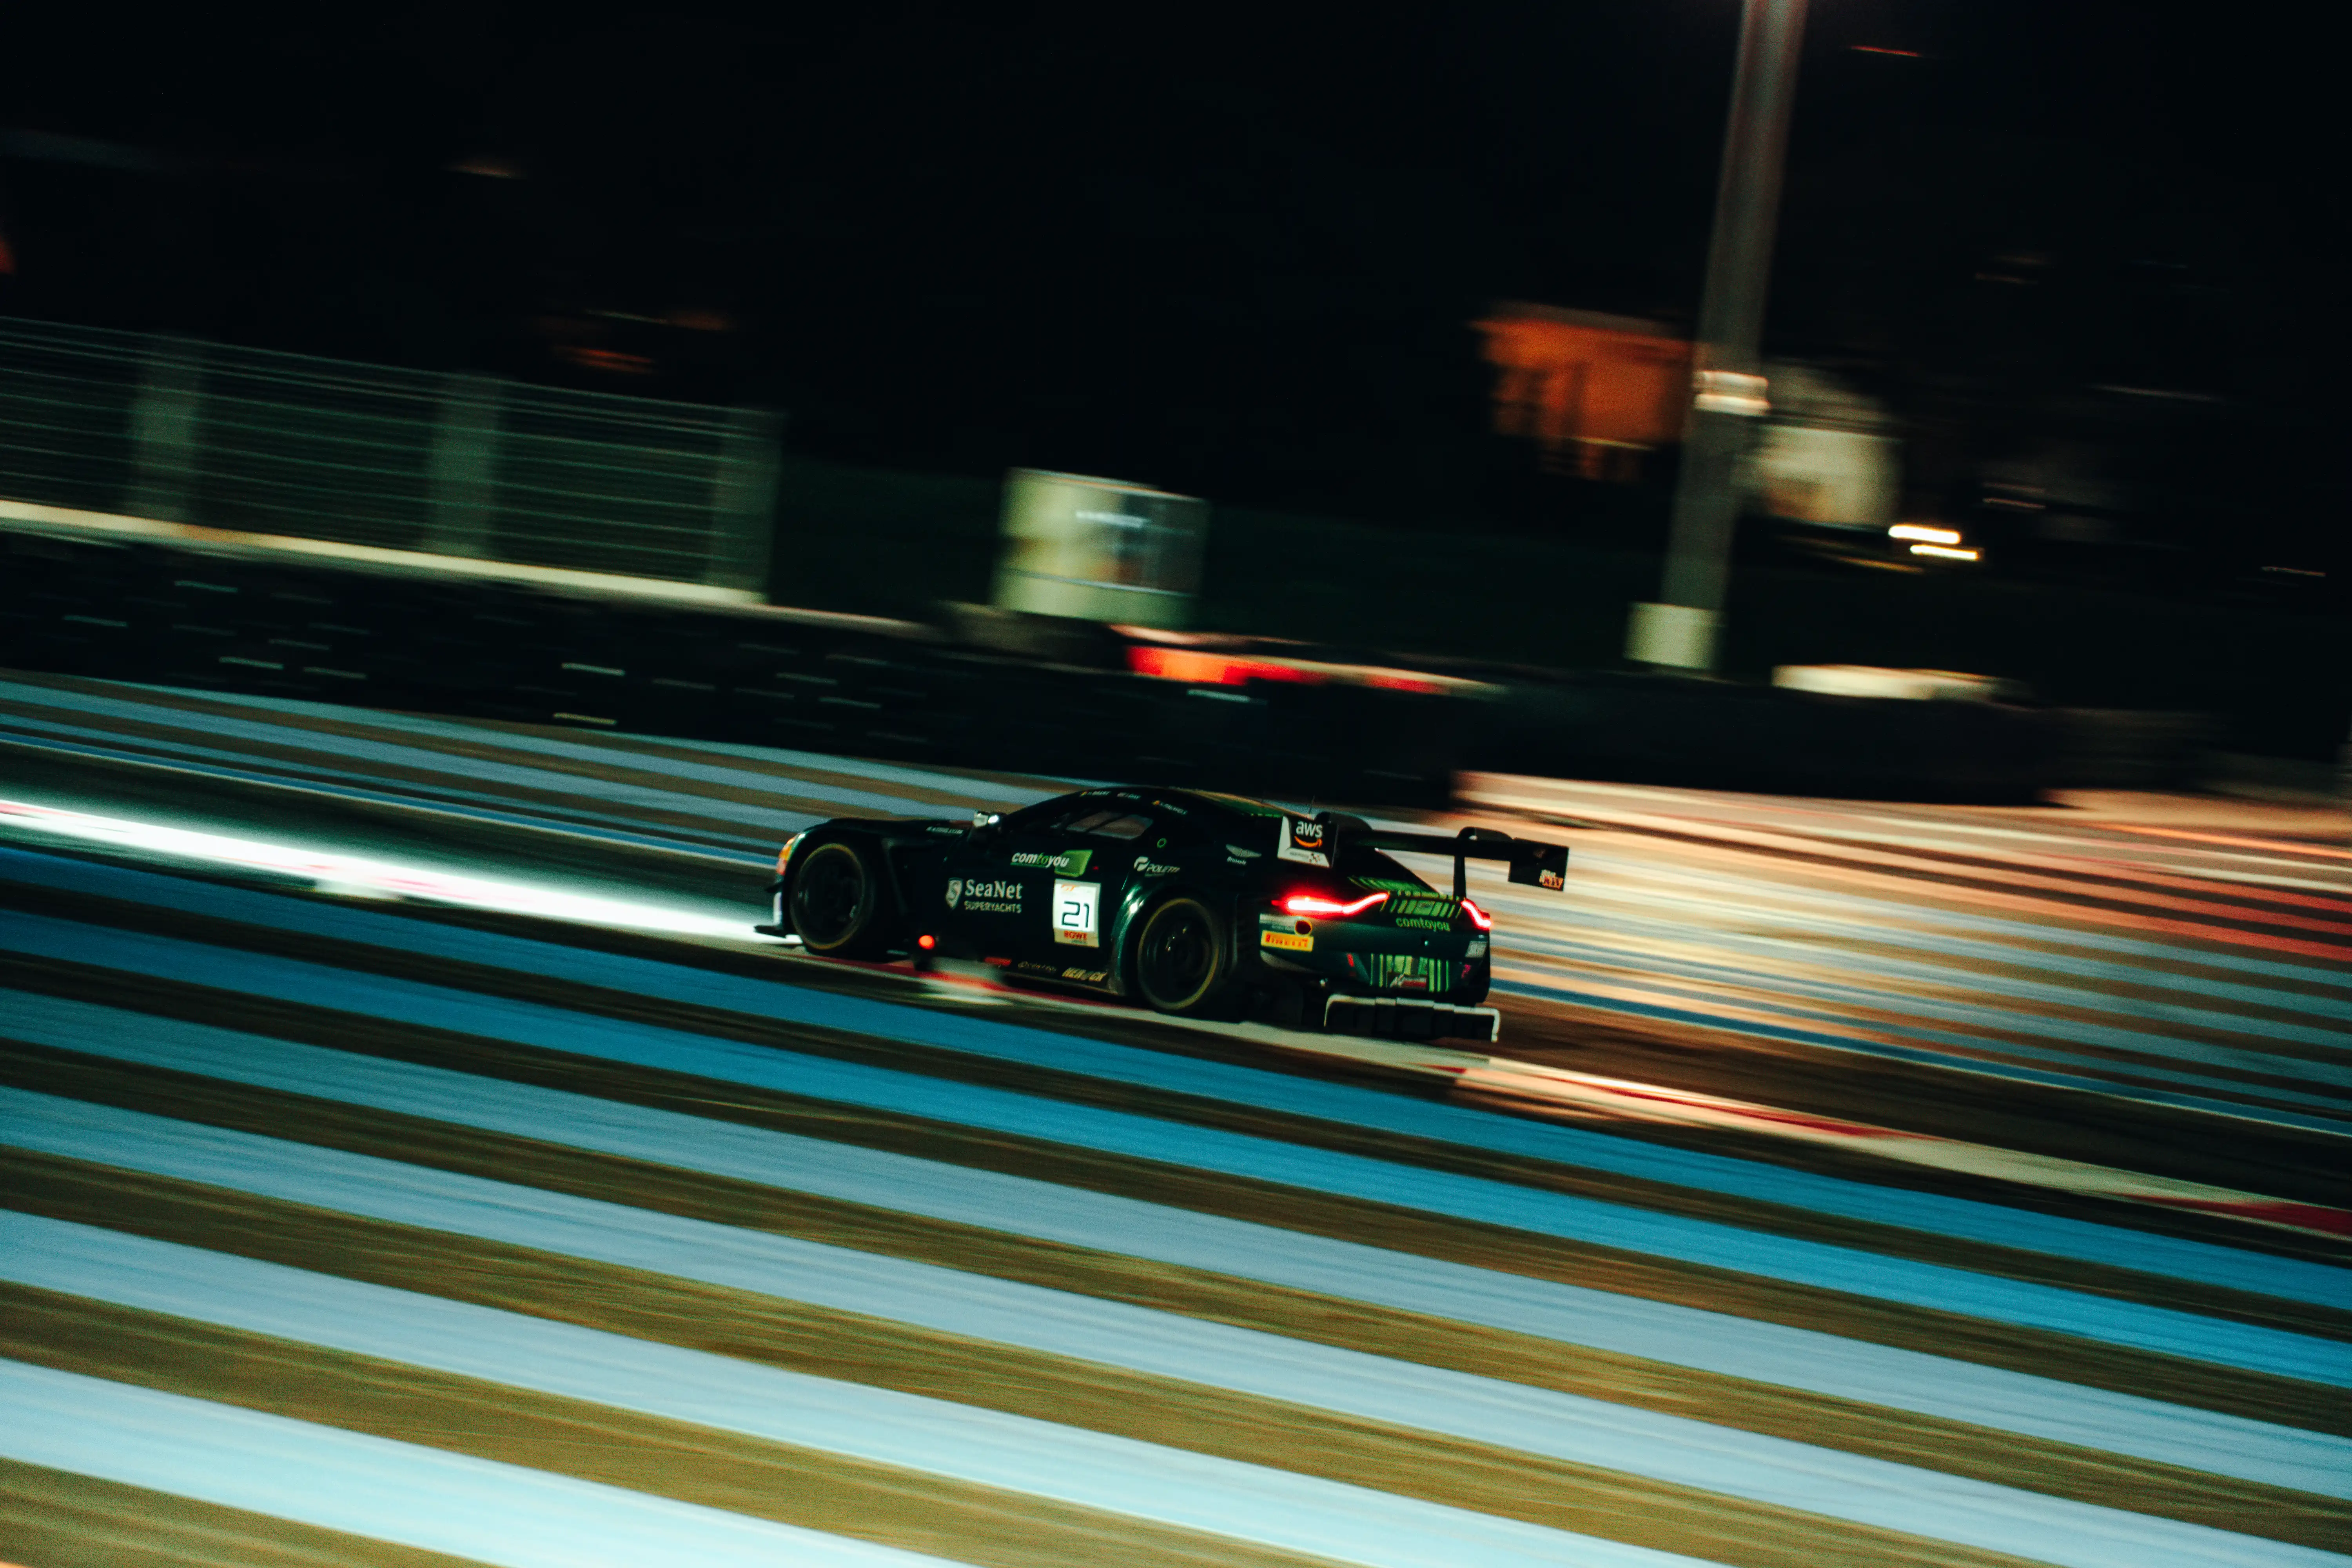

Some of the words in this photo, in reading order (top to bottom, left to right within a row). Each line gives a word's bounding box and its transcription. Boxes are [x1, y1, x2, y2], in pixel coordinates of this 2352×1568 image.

[1296, 821, 1323, 838] aws
[1011, 852, 1069, 868] comtoyou
[964, 878, 1024, 900] SeaNet
[964, 900, 1022, 914] SUPERYACHTS
[1061, 900, 1090, 928] 21
[1396, 917, 1450, 932] comtoyou
